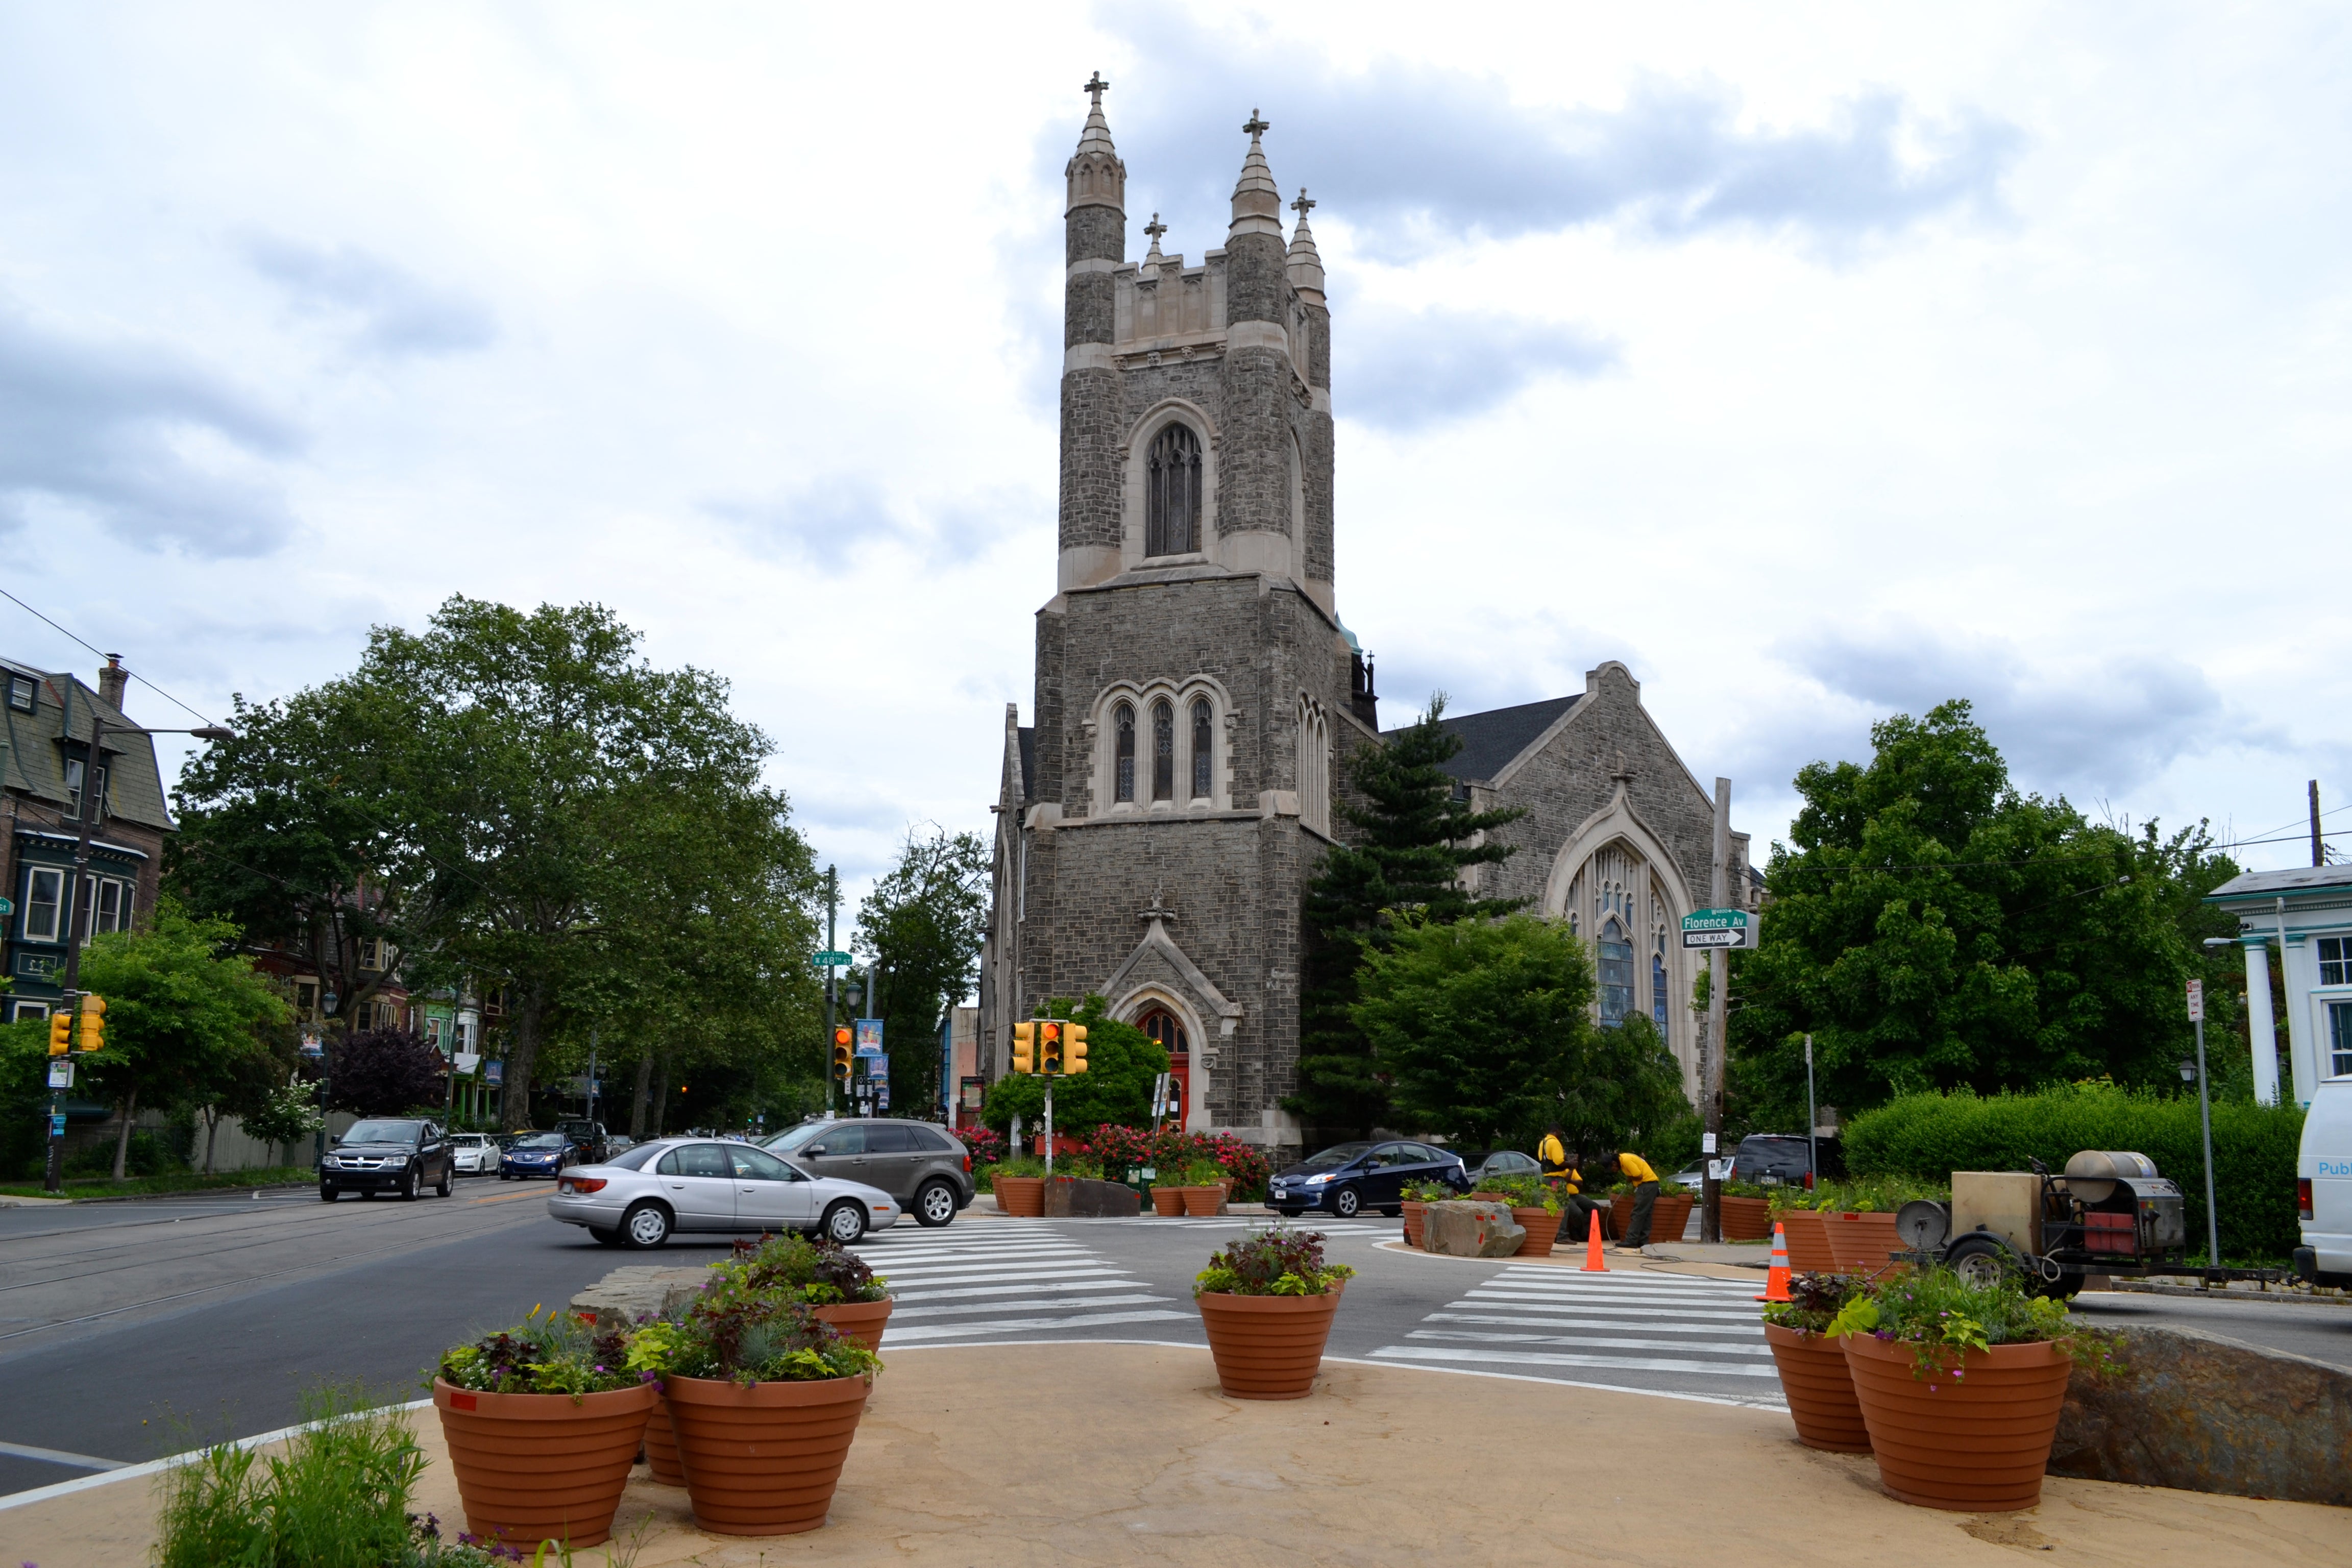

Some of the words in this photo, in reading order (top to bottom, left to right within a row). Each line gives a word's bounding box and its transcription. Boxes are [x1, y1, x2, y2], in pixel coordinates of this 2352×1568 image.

[1685, 918, 1727, 928] Florence
[1732, 917, 1744, 926] Av
[1690, 935, 1707, 943] ONE
